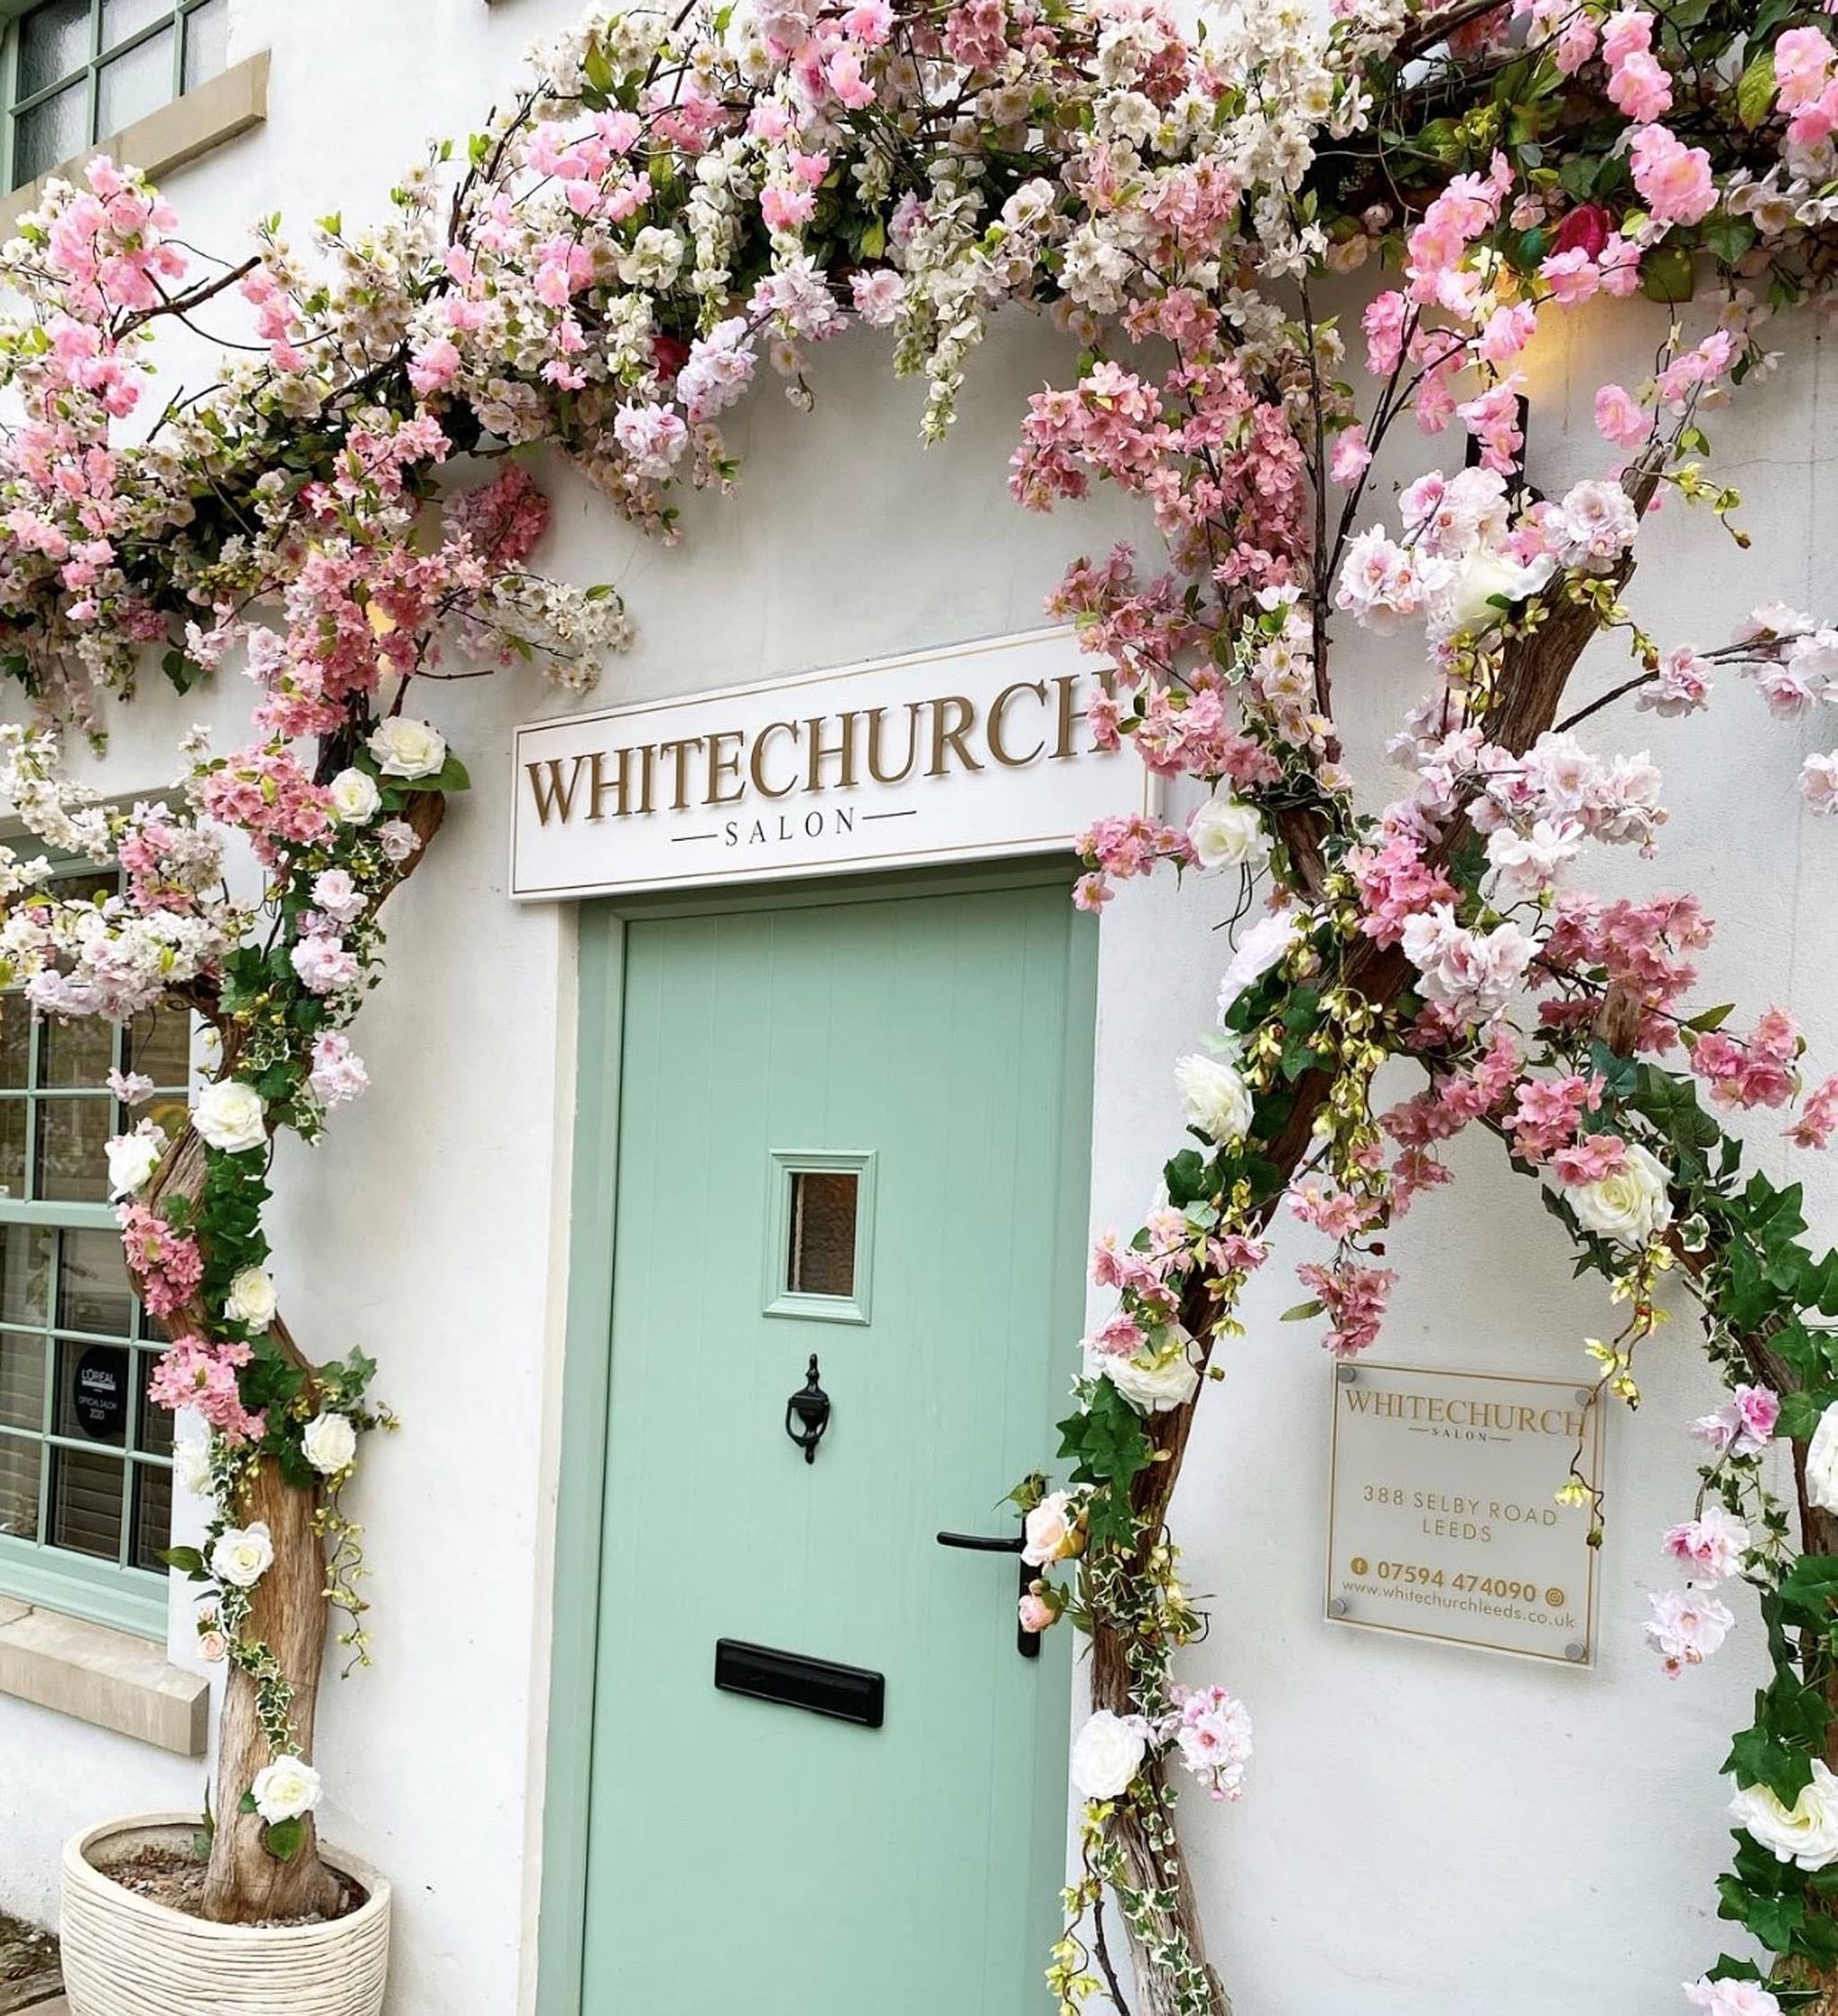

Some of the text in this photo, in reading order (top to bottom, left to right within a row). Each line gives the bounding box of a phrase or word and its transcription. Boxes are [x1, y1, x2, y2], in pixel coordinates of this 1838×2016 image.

[526, 669, 1119, 826] WHITECHURCH
[725, 807, 855, 846] SALON
[1345, 1389, 1586, 1437] WHITECHURCH
[1431, 1427, 1488, 1442] SALON
[1363, 1486, 1557, 1526] 388 SELBY ROAD
[1422, 1519, 1492, 1543] LEEDS
[1377, 1561, 1536, 1603] 07594 474090
[1343, 1580, 1575, 1628] www.whitechurchleeds.co.uk
